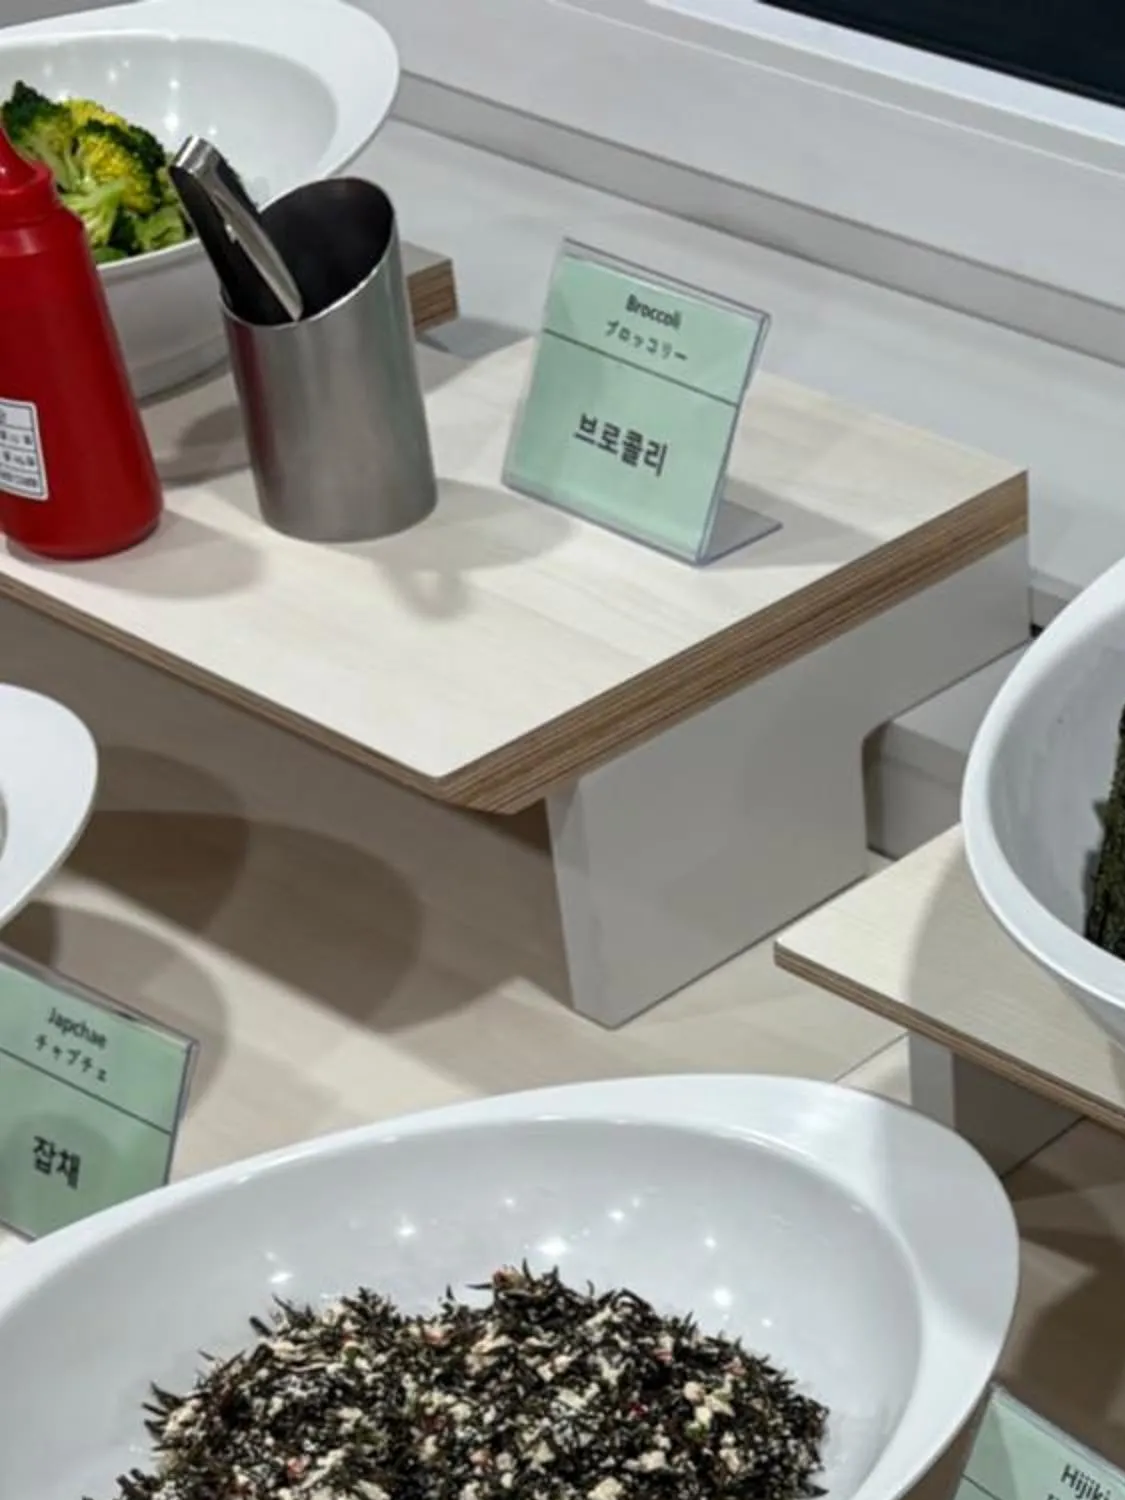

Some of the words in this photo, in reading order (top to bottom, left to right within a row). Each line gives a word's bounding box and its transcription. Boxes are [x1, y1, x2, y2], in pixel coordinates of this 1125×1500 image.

[626, 294, 682, 330] Broccoli
[605, 320, 688, 361] ブロッコリー
[573, 412, 668, 478] 브로콜리
[48, 1007, 107, 1049] Japchae
[33, 1135, 81, 1190] 잡채
